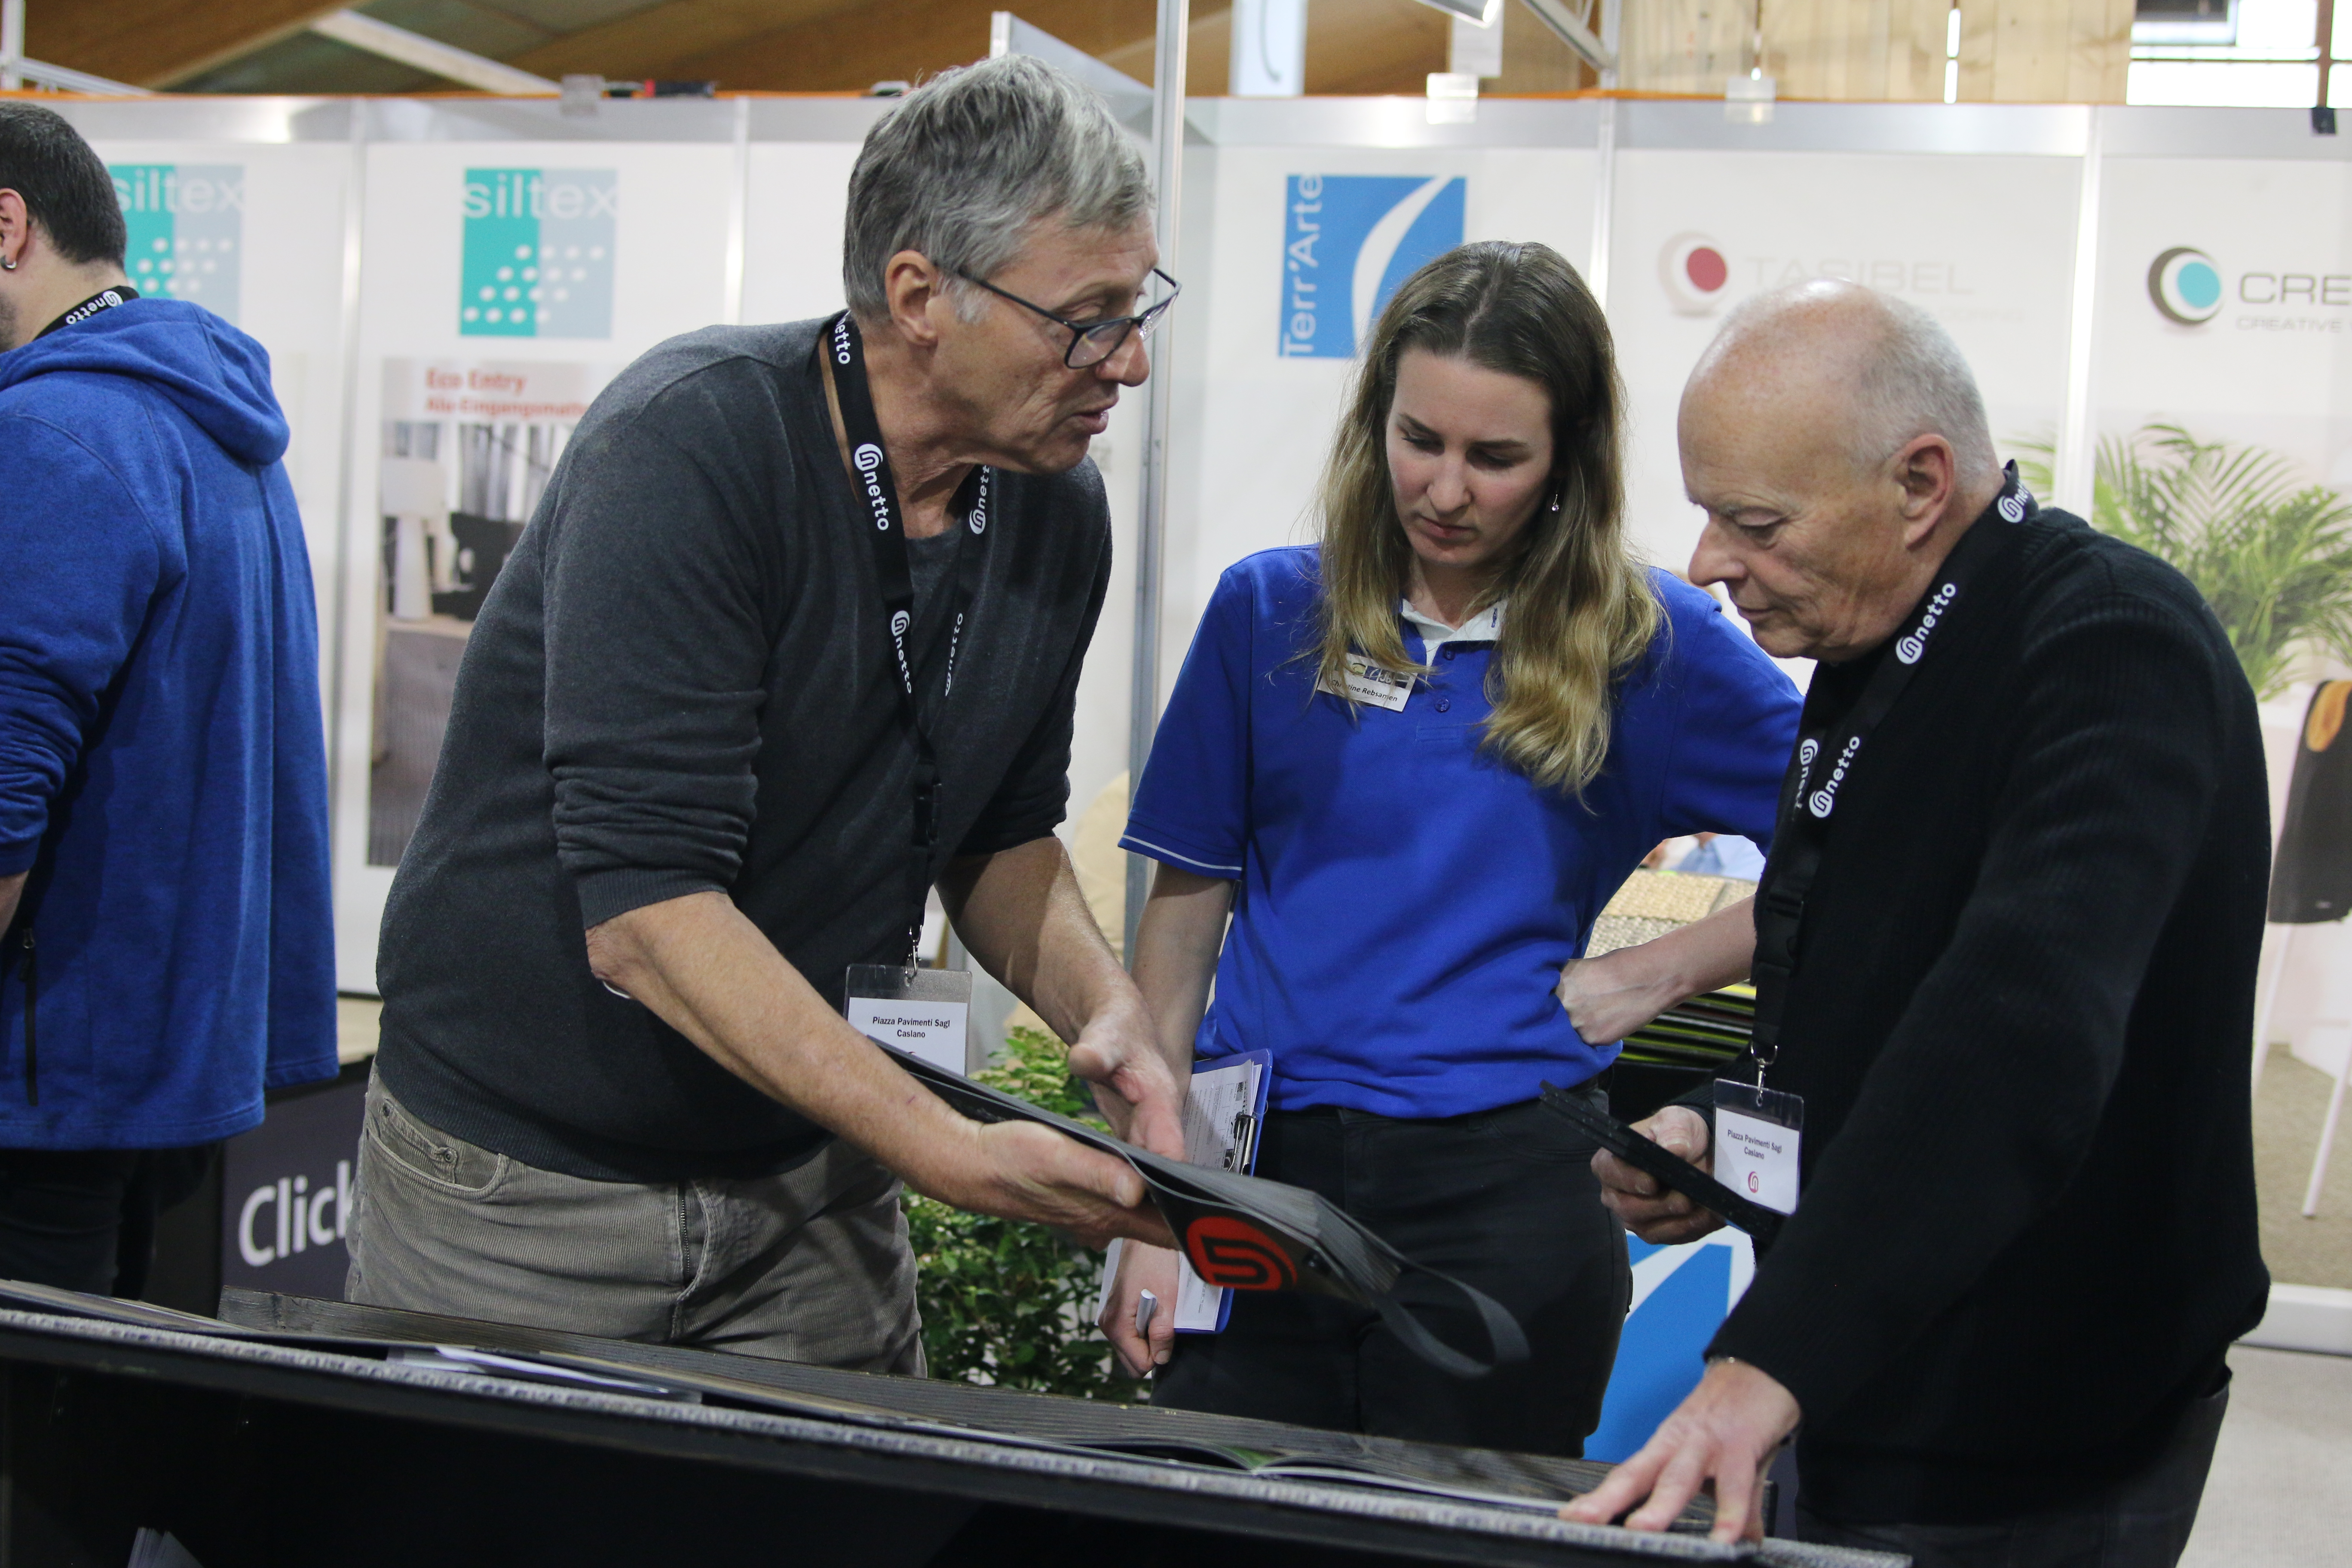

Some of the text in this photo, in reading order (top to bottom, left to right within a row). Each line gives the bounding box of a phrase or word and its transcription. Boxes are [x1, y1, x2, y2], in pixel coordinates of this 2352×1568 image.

[116, 168, 246, 213] siltex
[462, 172, 619, 218] siltex
[1281, 172, 1324, 356] Terr'Arte
[66, 297, 107, 325] netto
[864, 471, 889, 531] netto
[978, 465, 990, 509] nett
[1915, 582, 1957, 642] netto
[895, 636, 912, 694] netto
[1825, 736, 1860, 794] netto
[873, 1017, 950, 1029] Piazza Pavimenti Sagl
[1727, 1129, 1743, 1141] Piazza
[1745, 1134, 1770, 1149] Pavimenti
